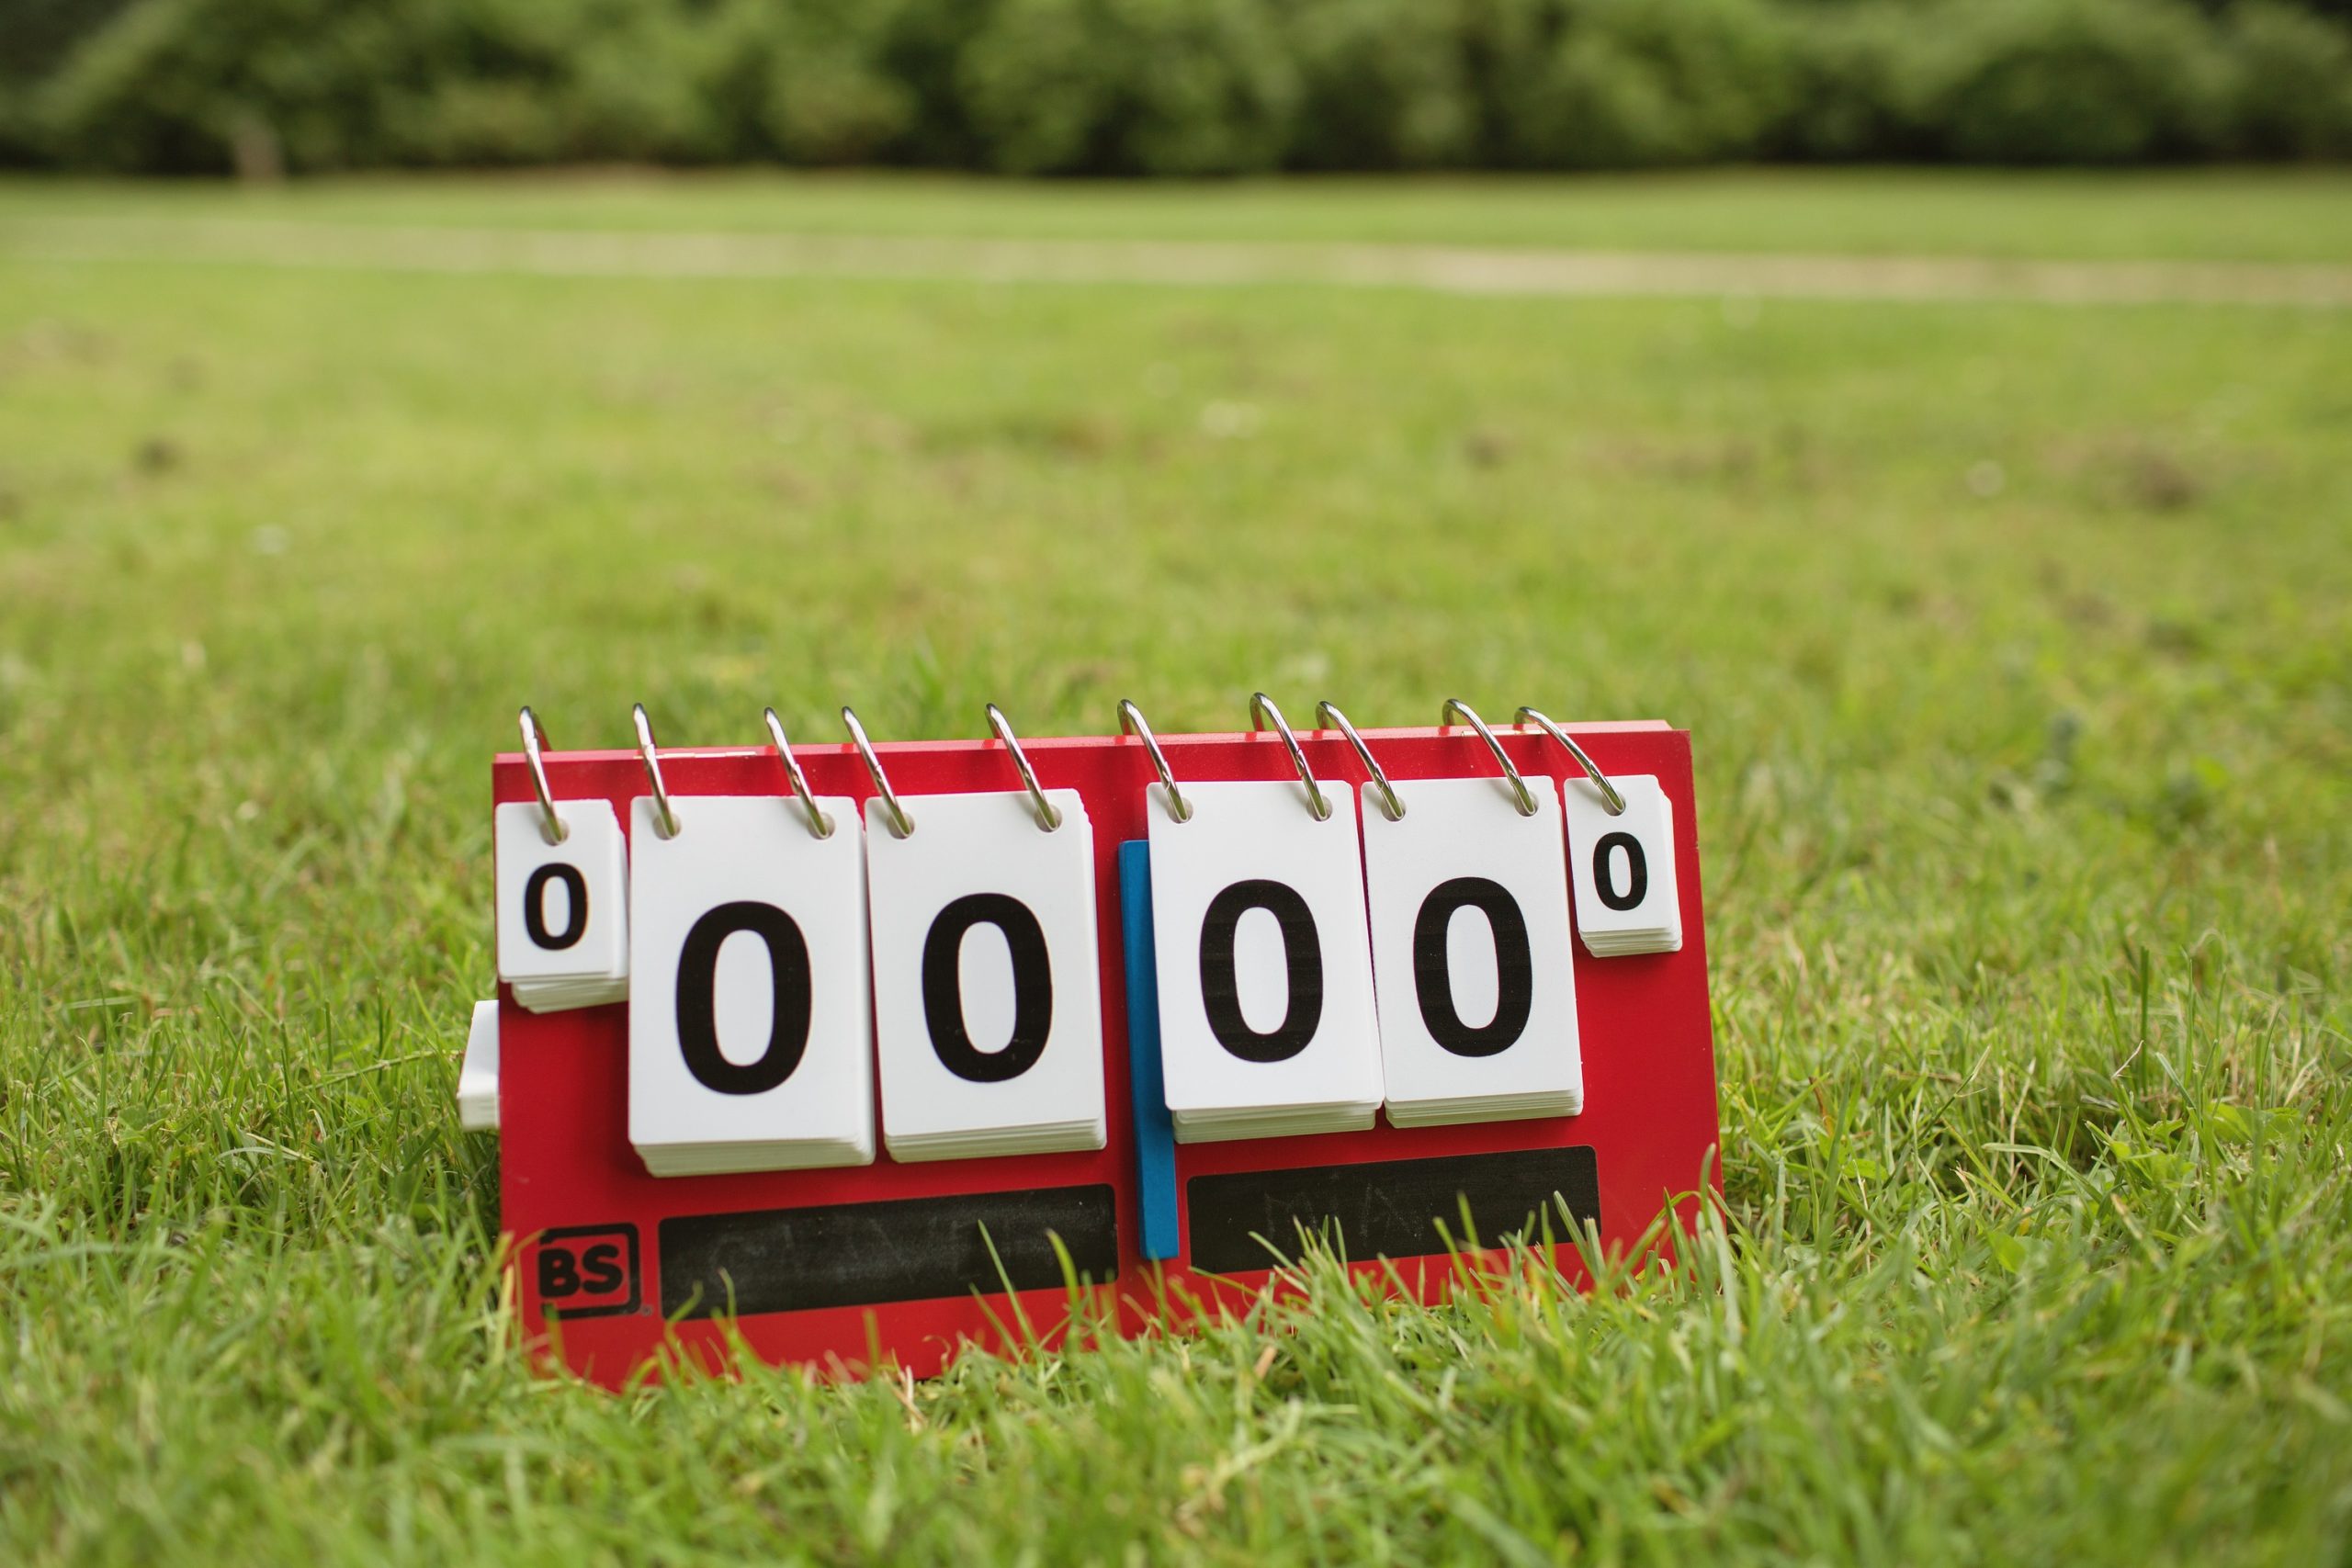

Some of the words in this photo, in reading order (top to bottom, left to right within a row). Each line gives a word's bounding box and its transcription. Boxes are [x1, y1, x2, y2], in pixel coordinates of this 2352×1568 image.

[525, 863, 588, 951] 0
[676, 901, 811, 1095] 0
[922, 893, 1053, 1083] 0
[1199, 879, 1323, 1063] 0
[1413, 876, 1532, 1057] 0
[1592, 831, 1647, 911] 0
[538, 1244, 623, 1298] BS
